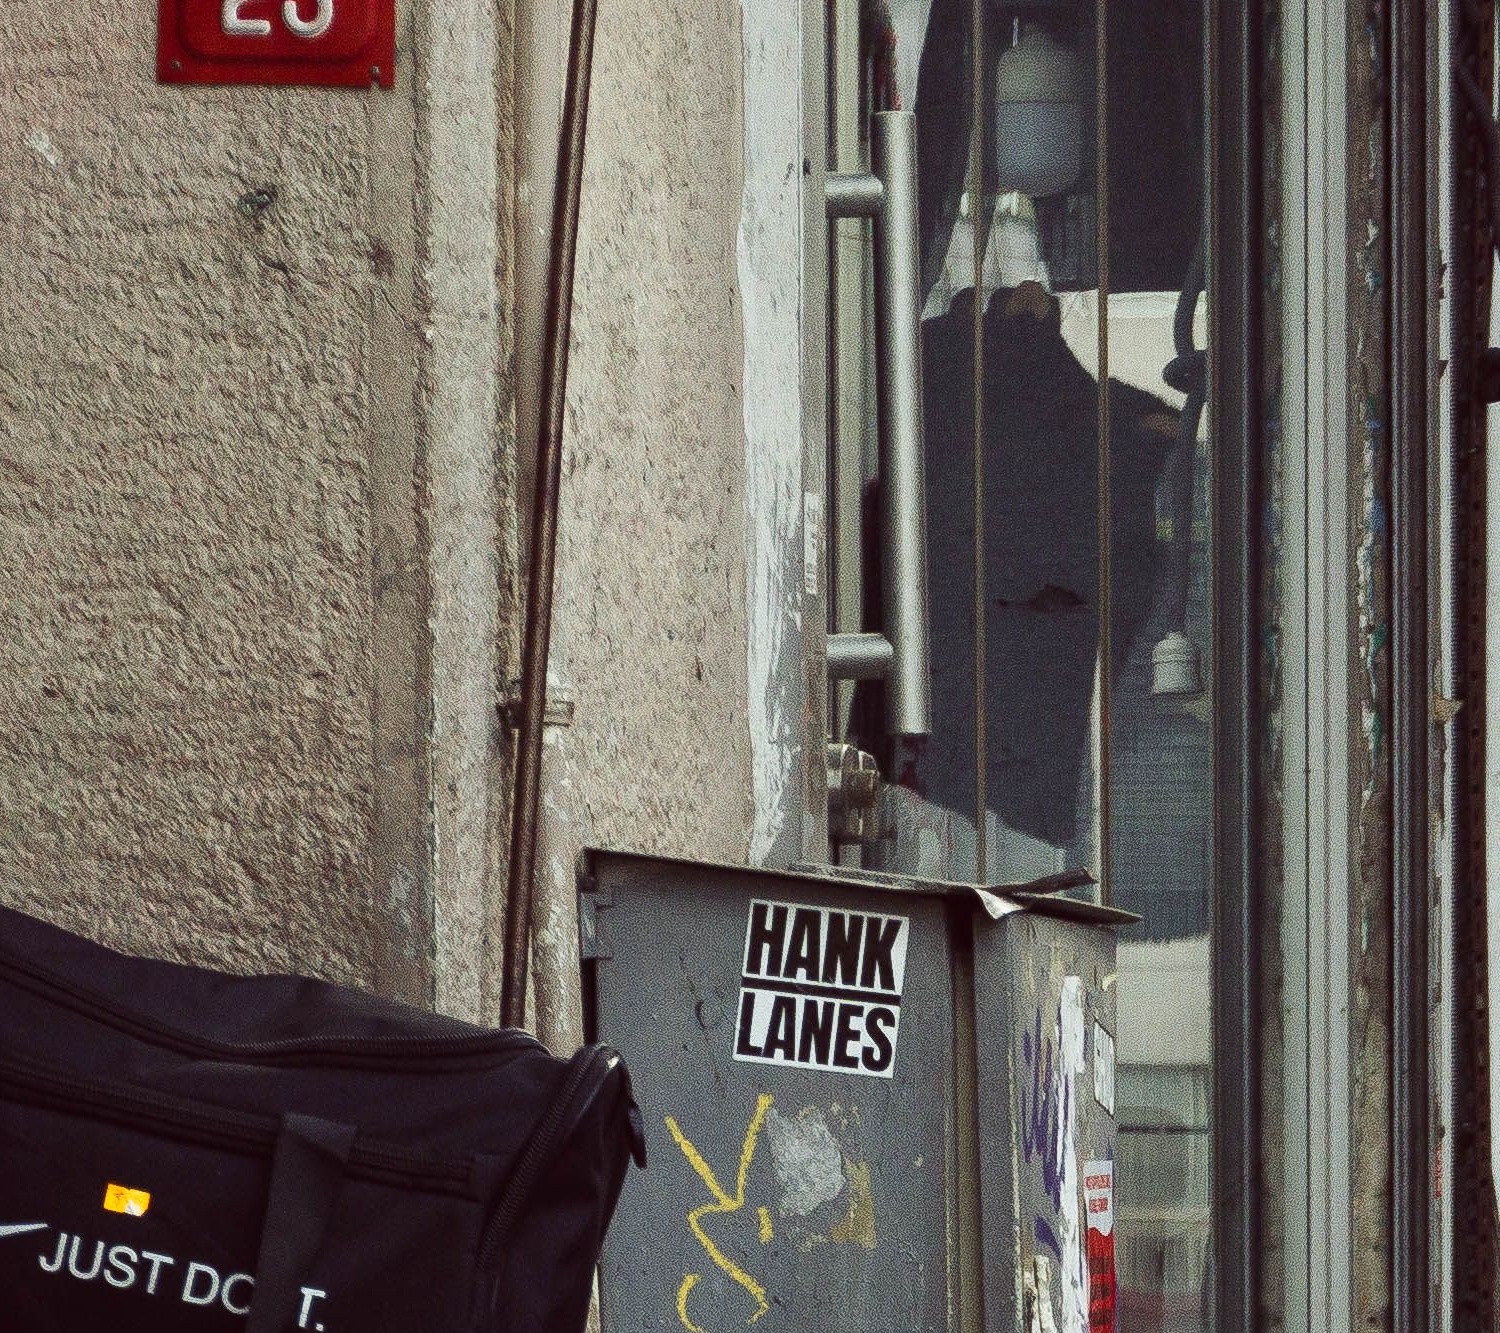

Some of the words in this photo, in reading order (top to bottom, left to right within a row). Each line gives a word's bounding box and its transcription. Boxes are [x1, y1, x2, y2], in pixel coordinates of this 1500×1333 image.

[747, 905, 900, 992] HANK
[738, 996, 894, 1074] LANES
[38, 1231, 175, 1296] JUST
